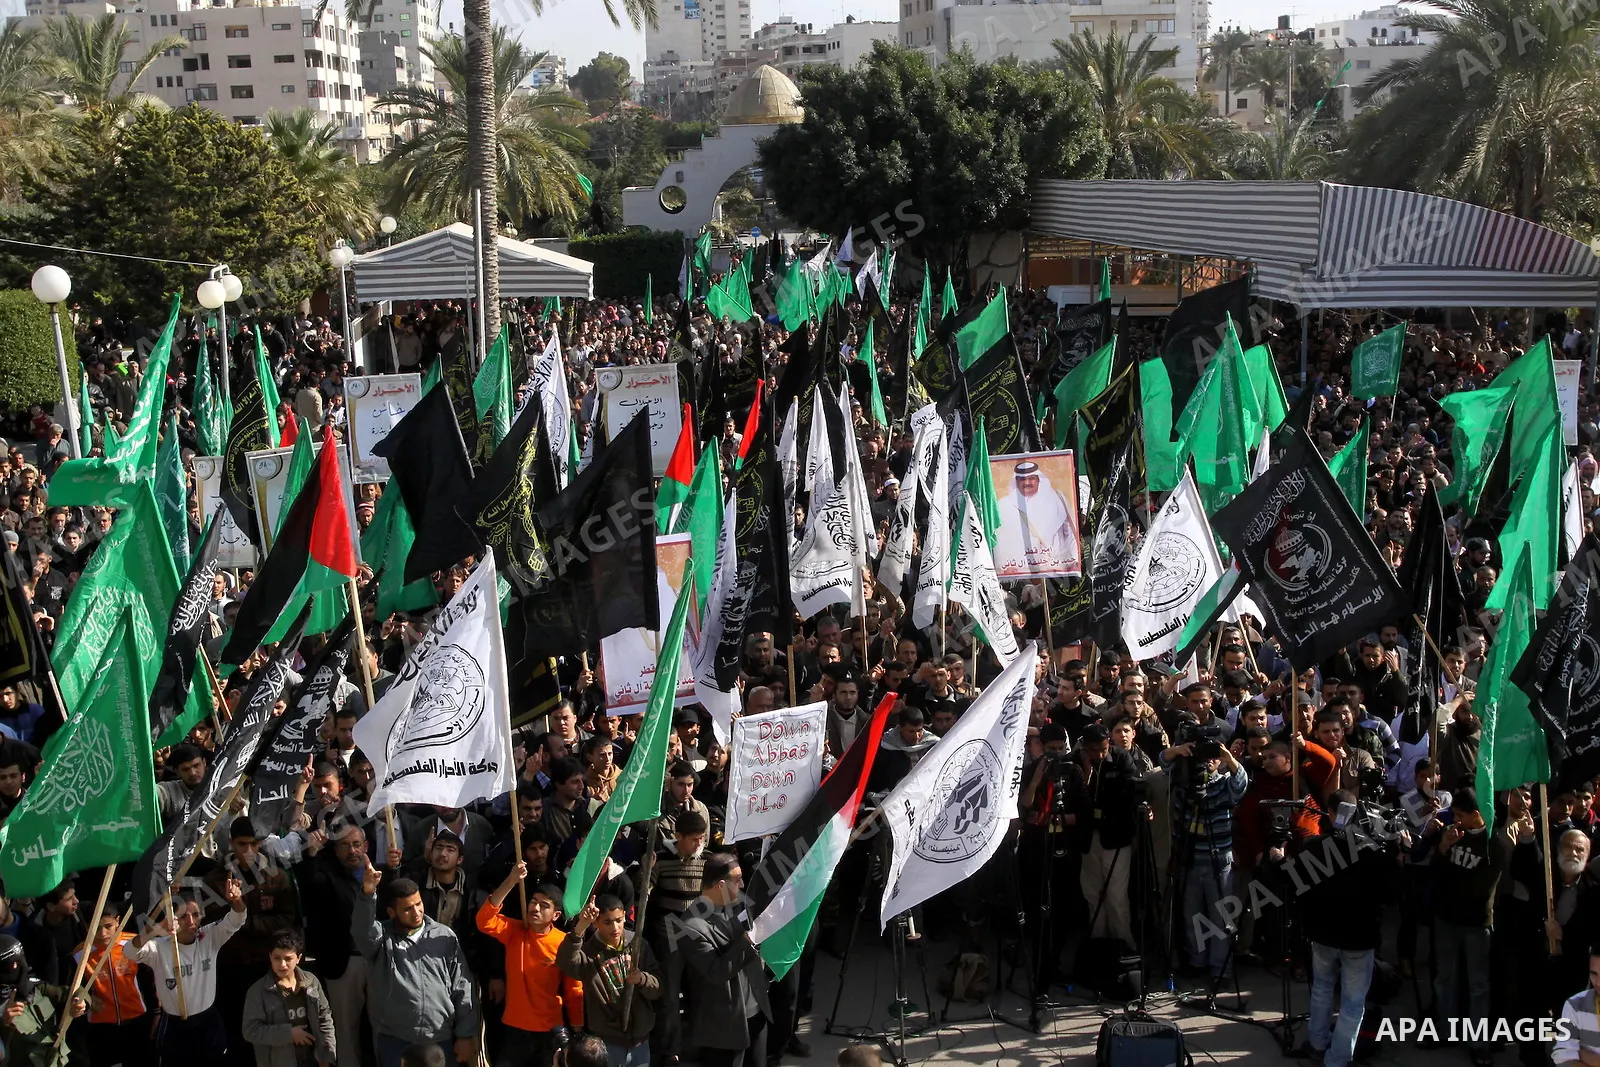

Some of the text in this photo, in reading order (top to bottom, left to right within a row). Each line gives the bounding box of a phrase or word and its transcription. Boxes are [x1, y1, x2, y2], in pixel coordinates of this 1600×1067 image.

[1320, 612, 1340, 630] هو
[1294, 621, 1319, 647] الحل
[748, 740, 810, 768] Abbas
[439, 757, 467, 779] الأحرار
[468, 759, 499, 776] حركة
[256, 784, 289, 805] الحل
